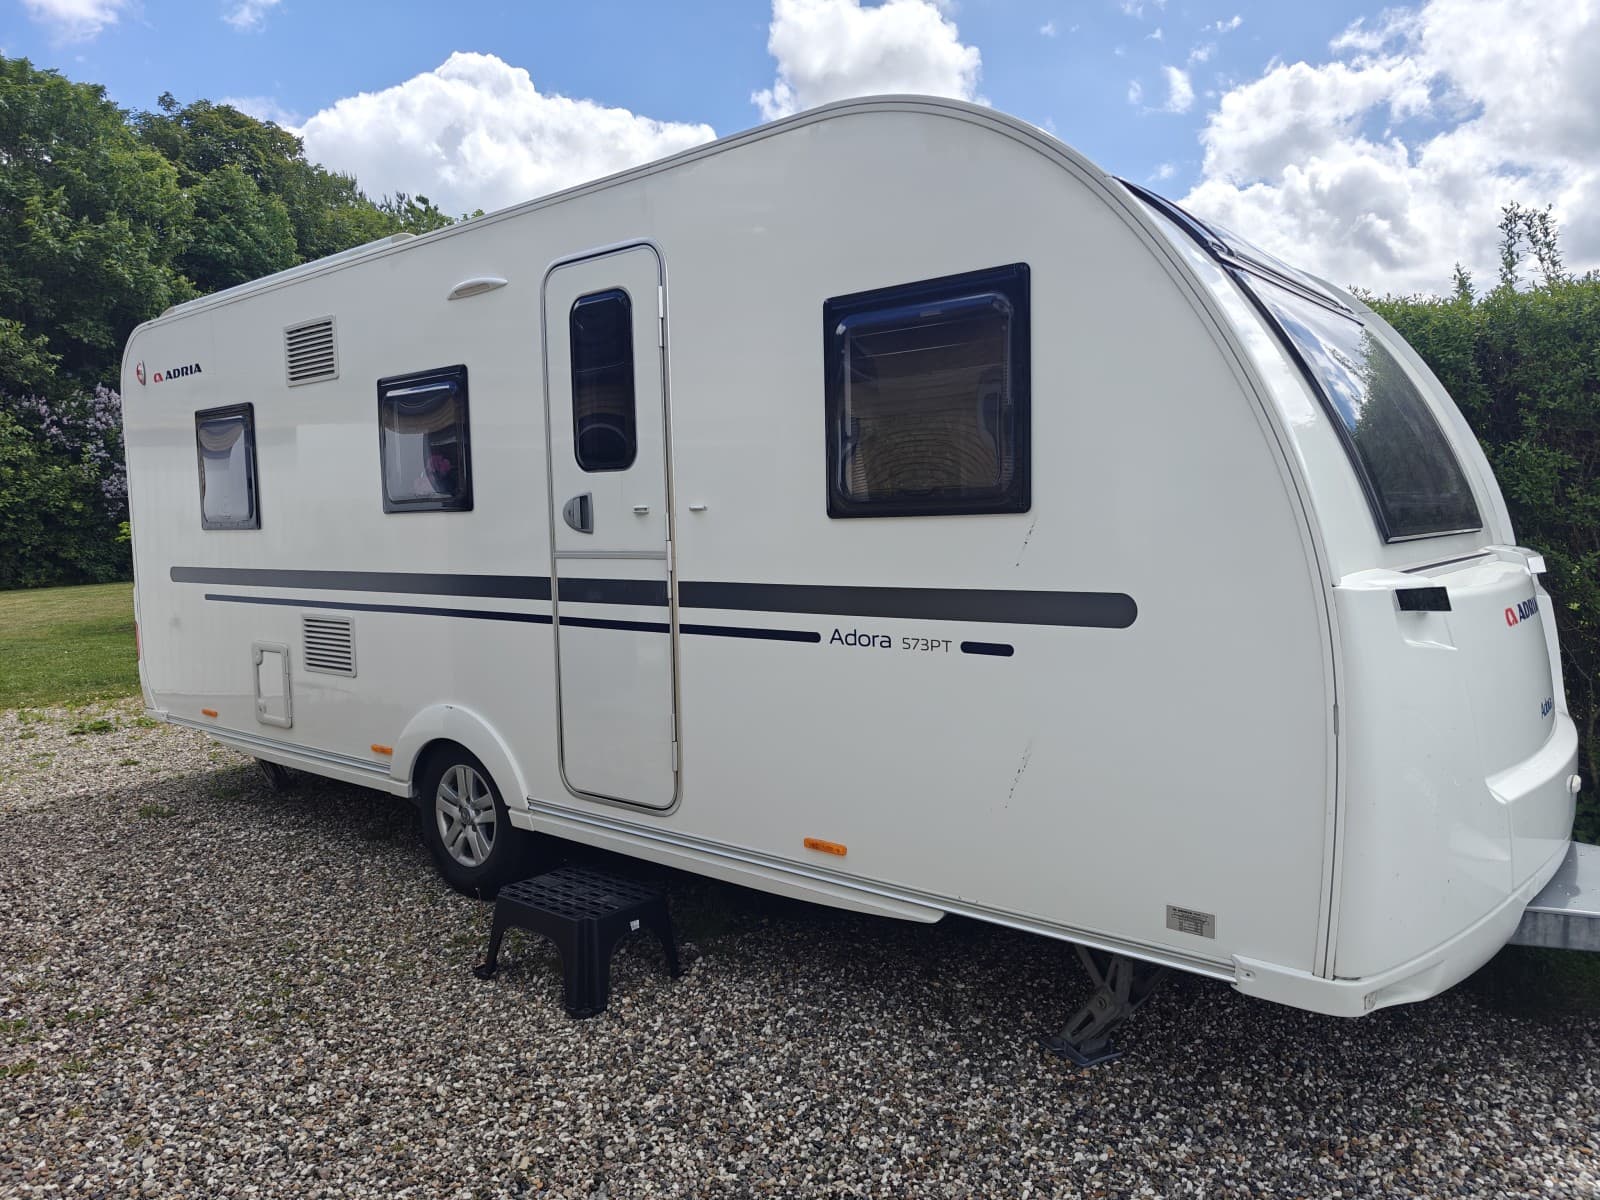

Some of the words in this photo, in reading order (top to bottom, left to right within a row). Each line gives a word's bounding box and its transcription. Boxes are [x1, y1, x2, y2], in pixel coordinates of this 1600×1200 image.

[165, 363, 202, 381] ADRIA
[829, 628, 892, 649] Adora
[902, 637, 952, 653] 573PT
